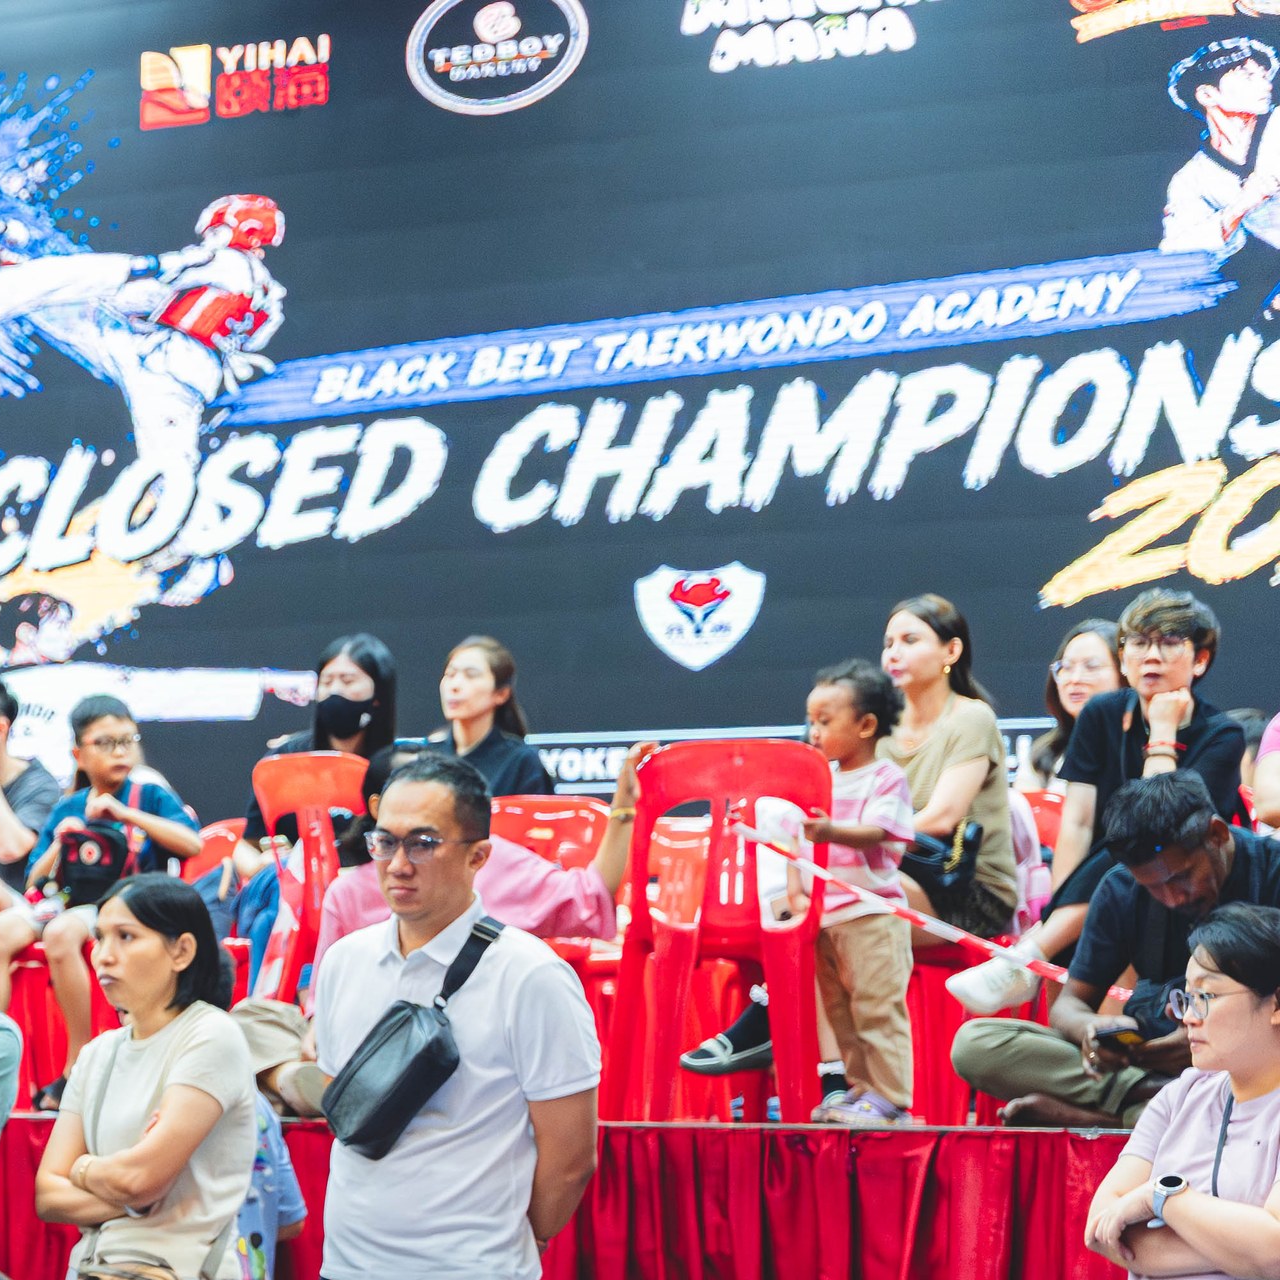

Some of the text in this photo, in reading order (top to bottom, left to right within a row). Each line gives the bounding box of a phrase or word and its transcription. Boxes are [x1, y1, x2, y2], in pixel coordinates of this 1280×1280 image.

[215, 33, 331, 74] YIHAI
[428, 32, 564, 73] TEDBOY
[312, 268, 1144, 406] BLACK BELT TAEKWONDO ACADEMY
